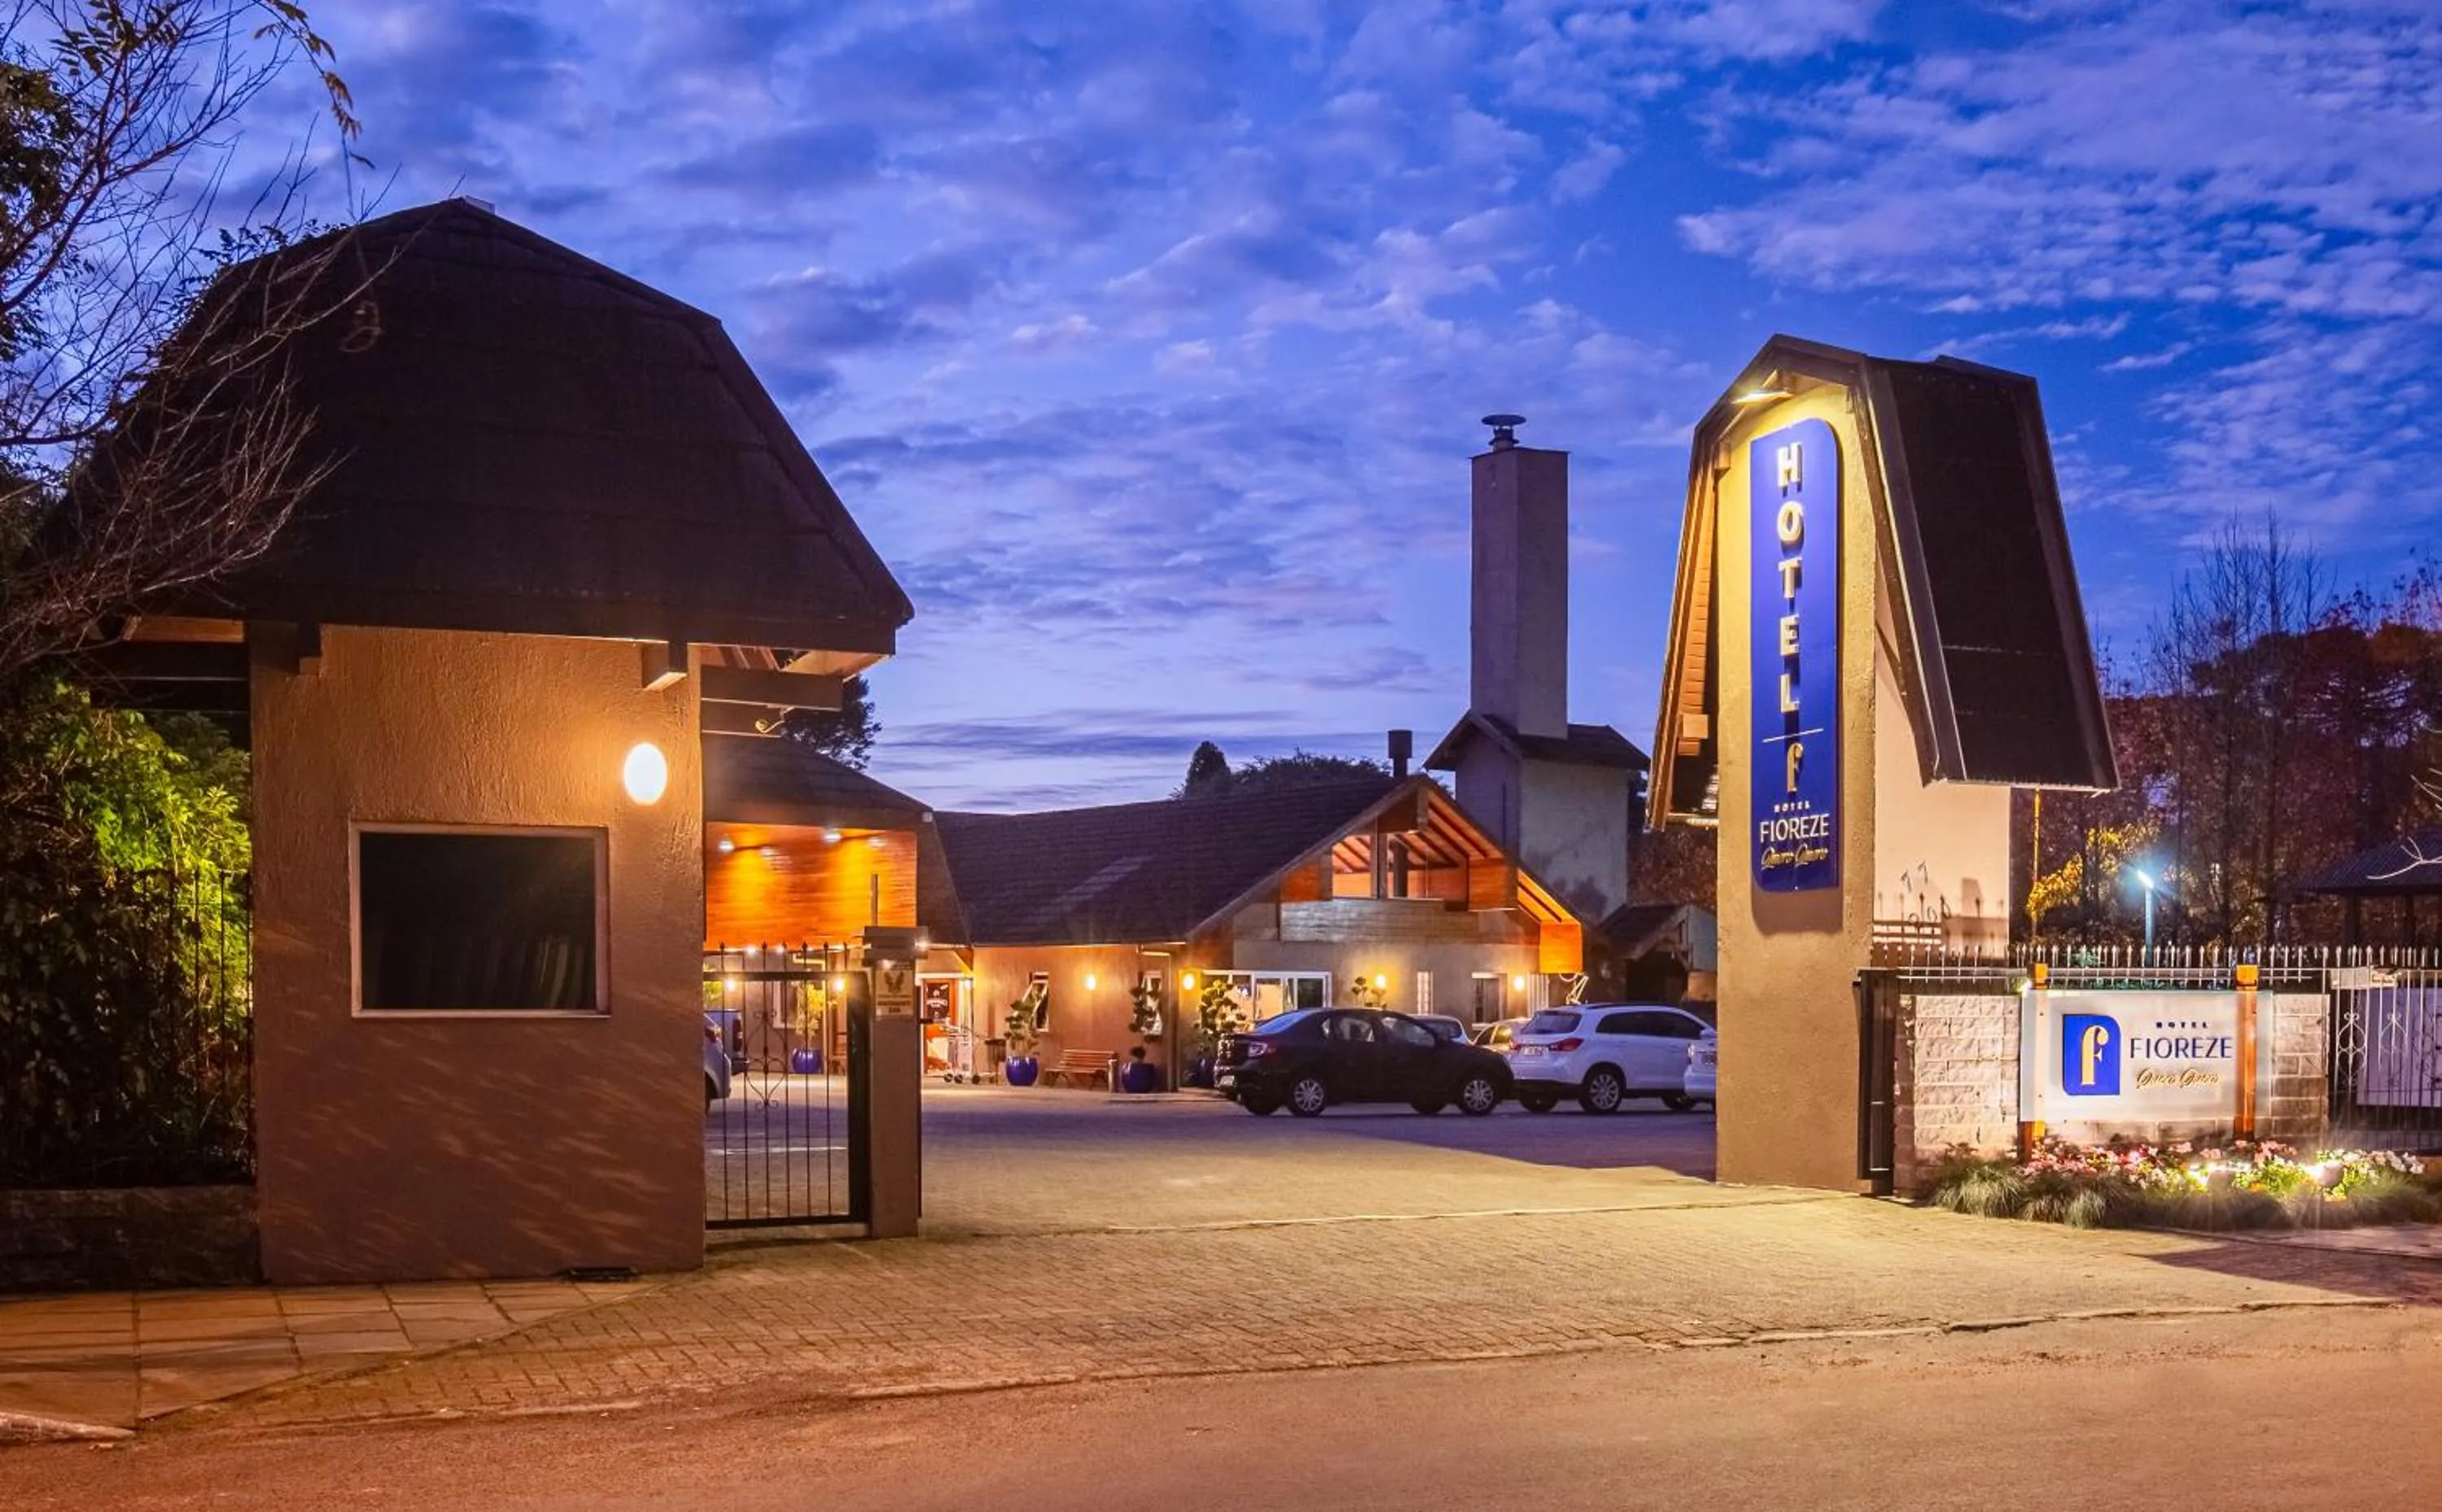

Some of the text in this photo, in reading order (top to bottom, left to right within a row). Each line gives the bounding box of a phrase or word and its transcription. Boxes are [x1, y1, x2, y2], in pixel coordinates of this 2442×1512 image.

[1776, 441, 1804, 714] HOTEL
[1759, 813, 1830, 844] FIOREZE
[2129, 1037, 2233, 1059] FIOREZE
